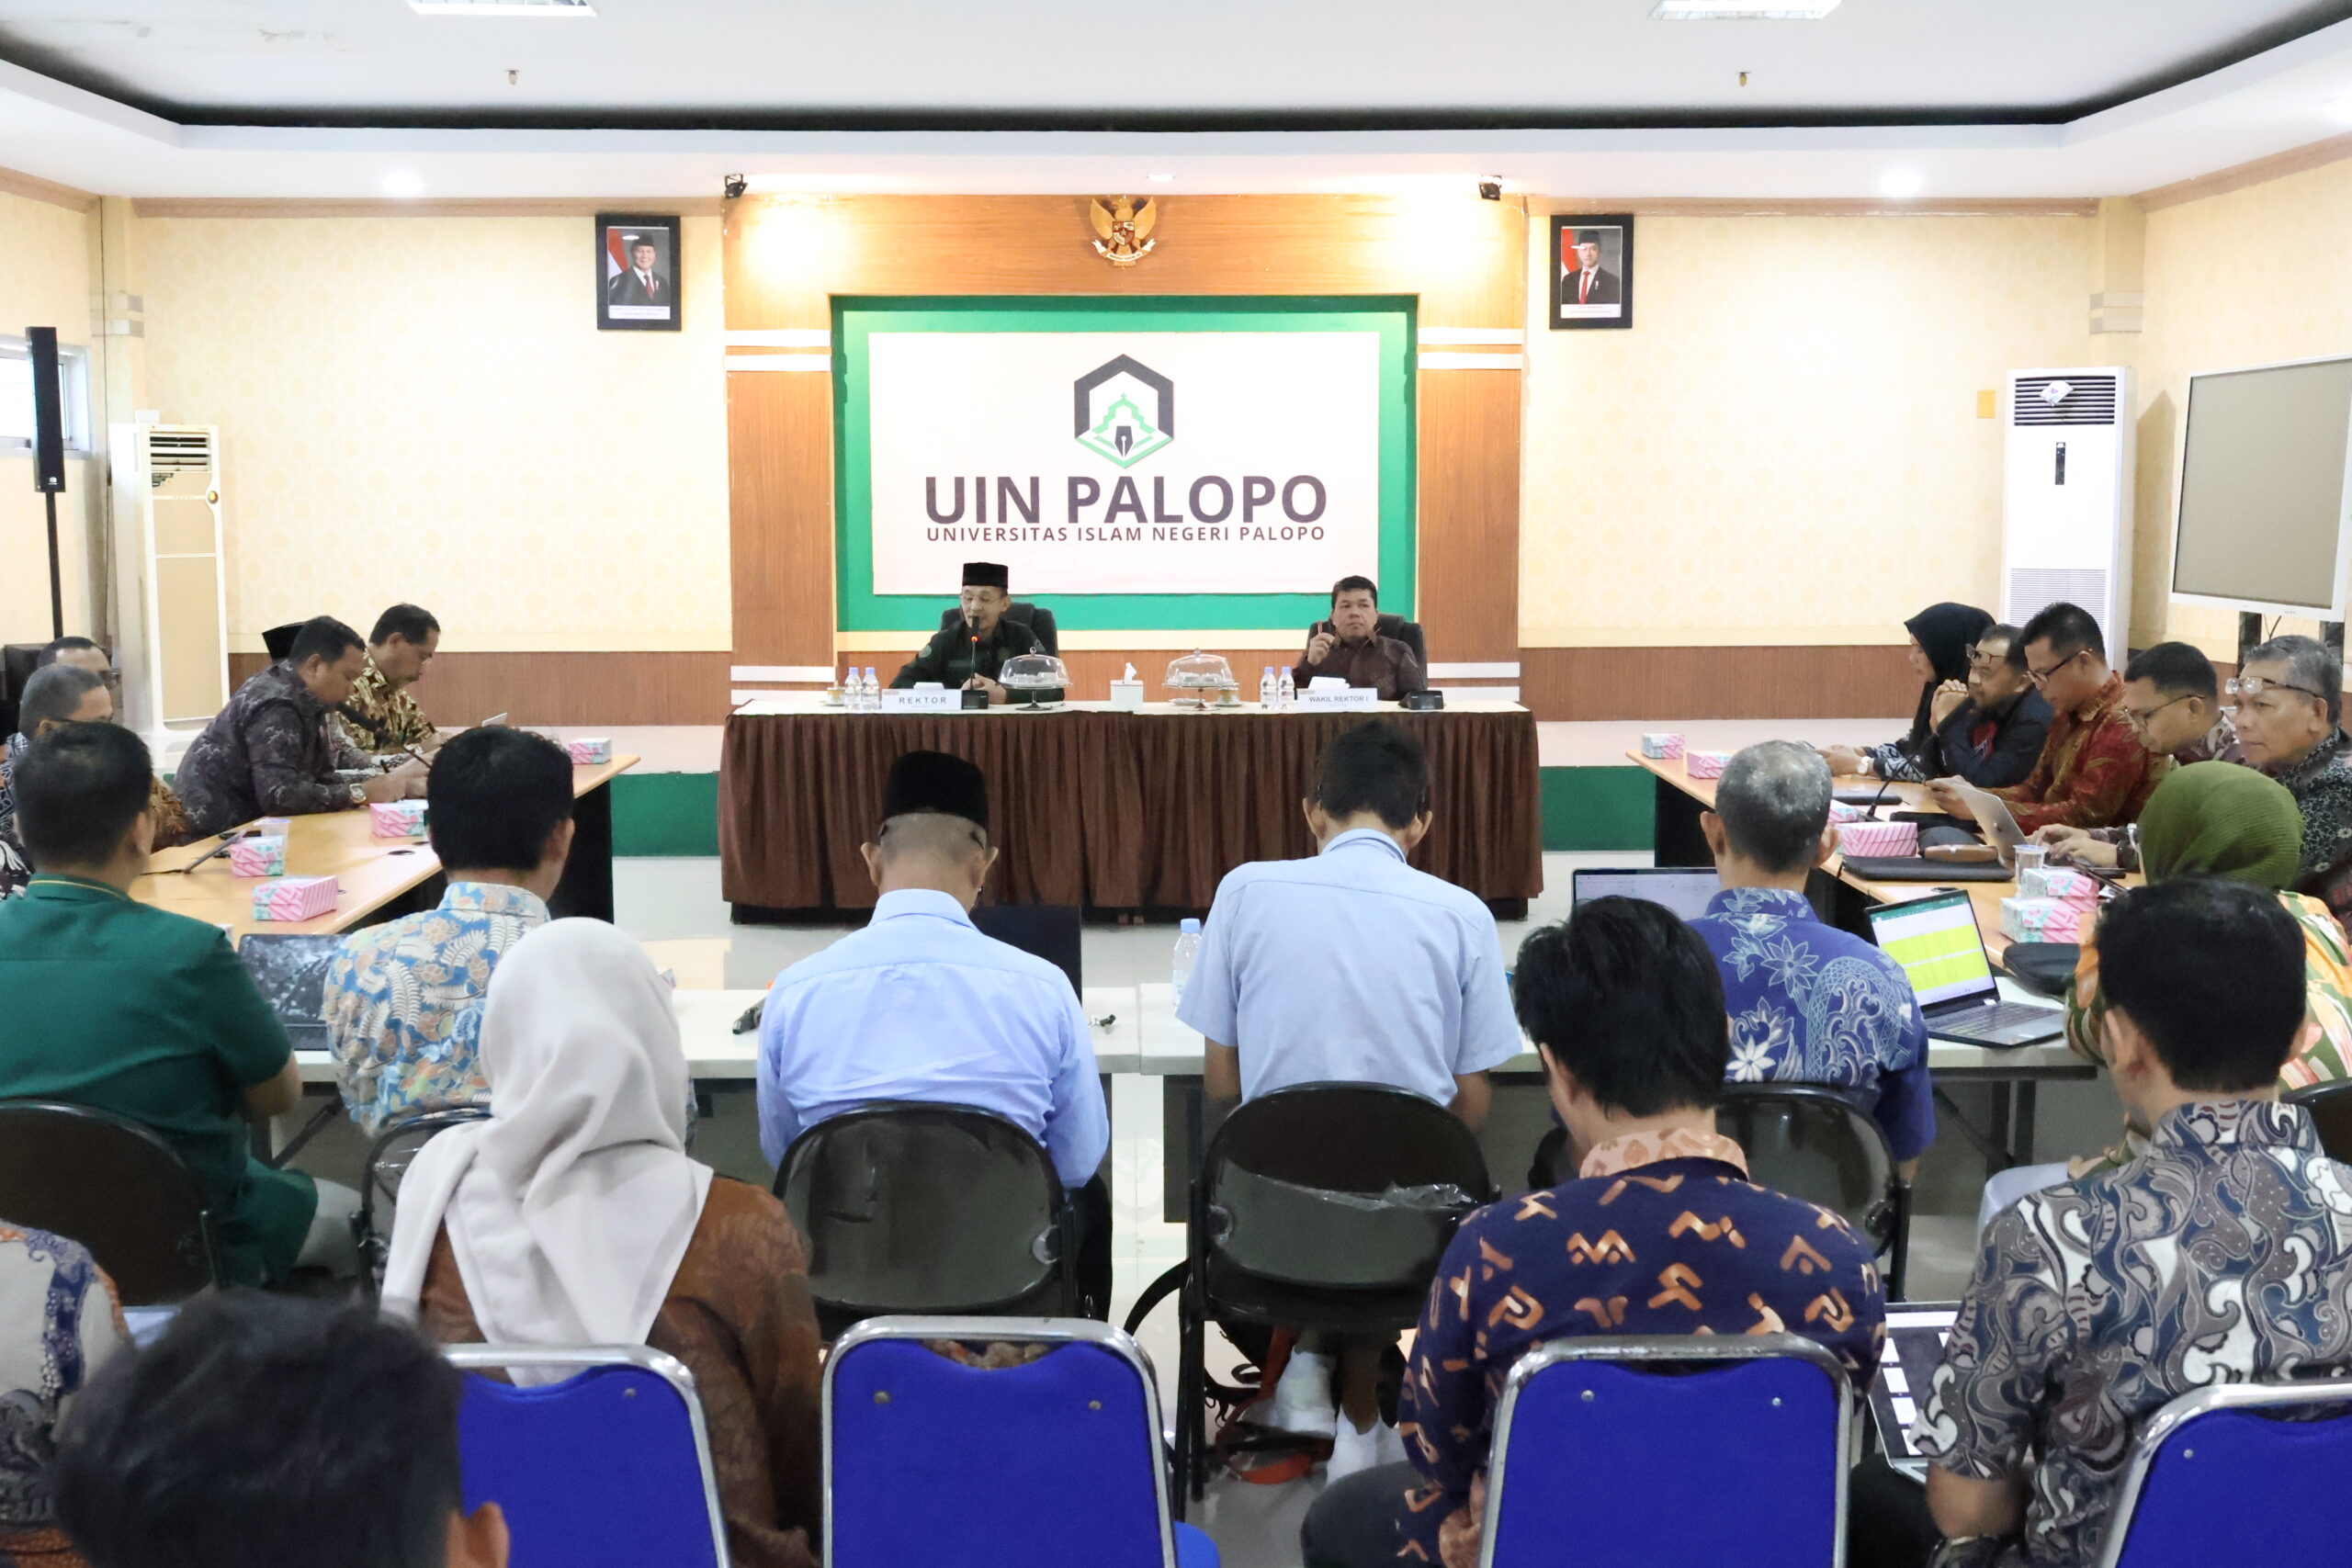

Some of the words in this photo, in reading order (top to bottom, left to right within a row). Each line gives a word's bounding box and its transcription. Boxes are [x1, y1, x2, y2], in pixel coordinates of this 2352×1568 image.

[925, 476, 1039, 525] UIN
[1068, 475, 1327, 524] PALOPO
[927, 527, 1068, 542] UNIVERSITAS
[1078, 527, 1141, 542] ISLAM
[1152, 527, 1228, 541] NEGERI
[1239, 526, 1325, 541] PALOPO
[899, 696, 947, 705] REKTOR
